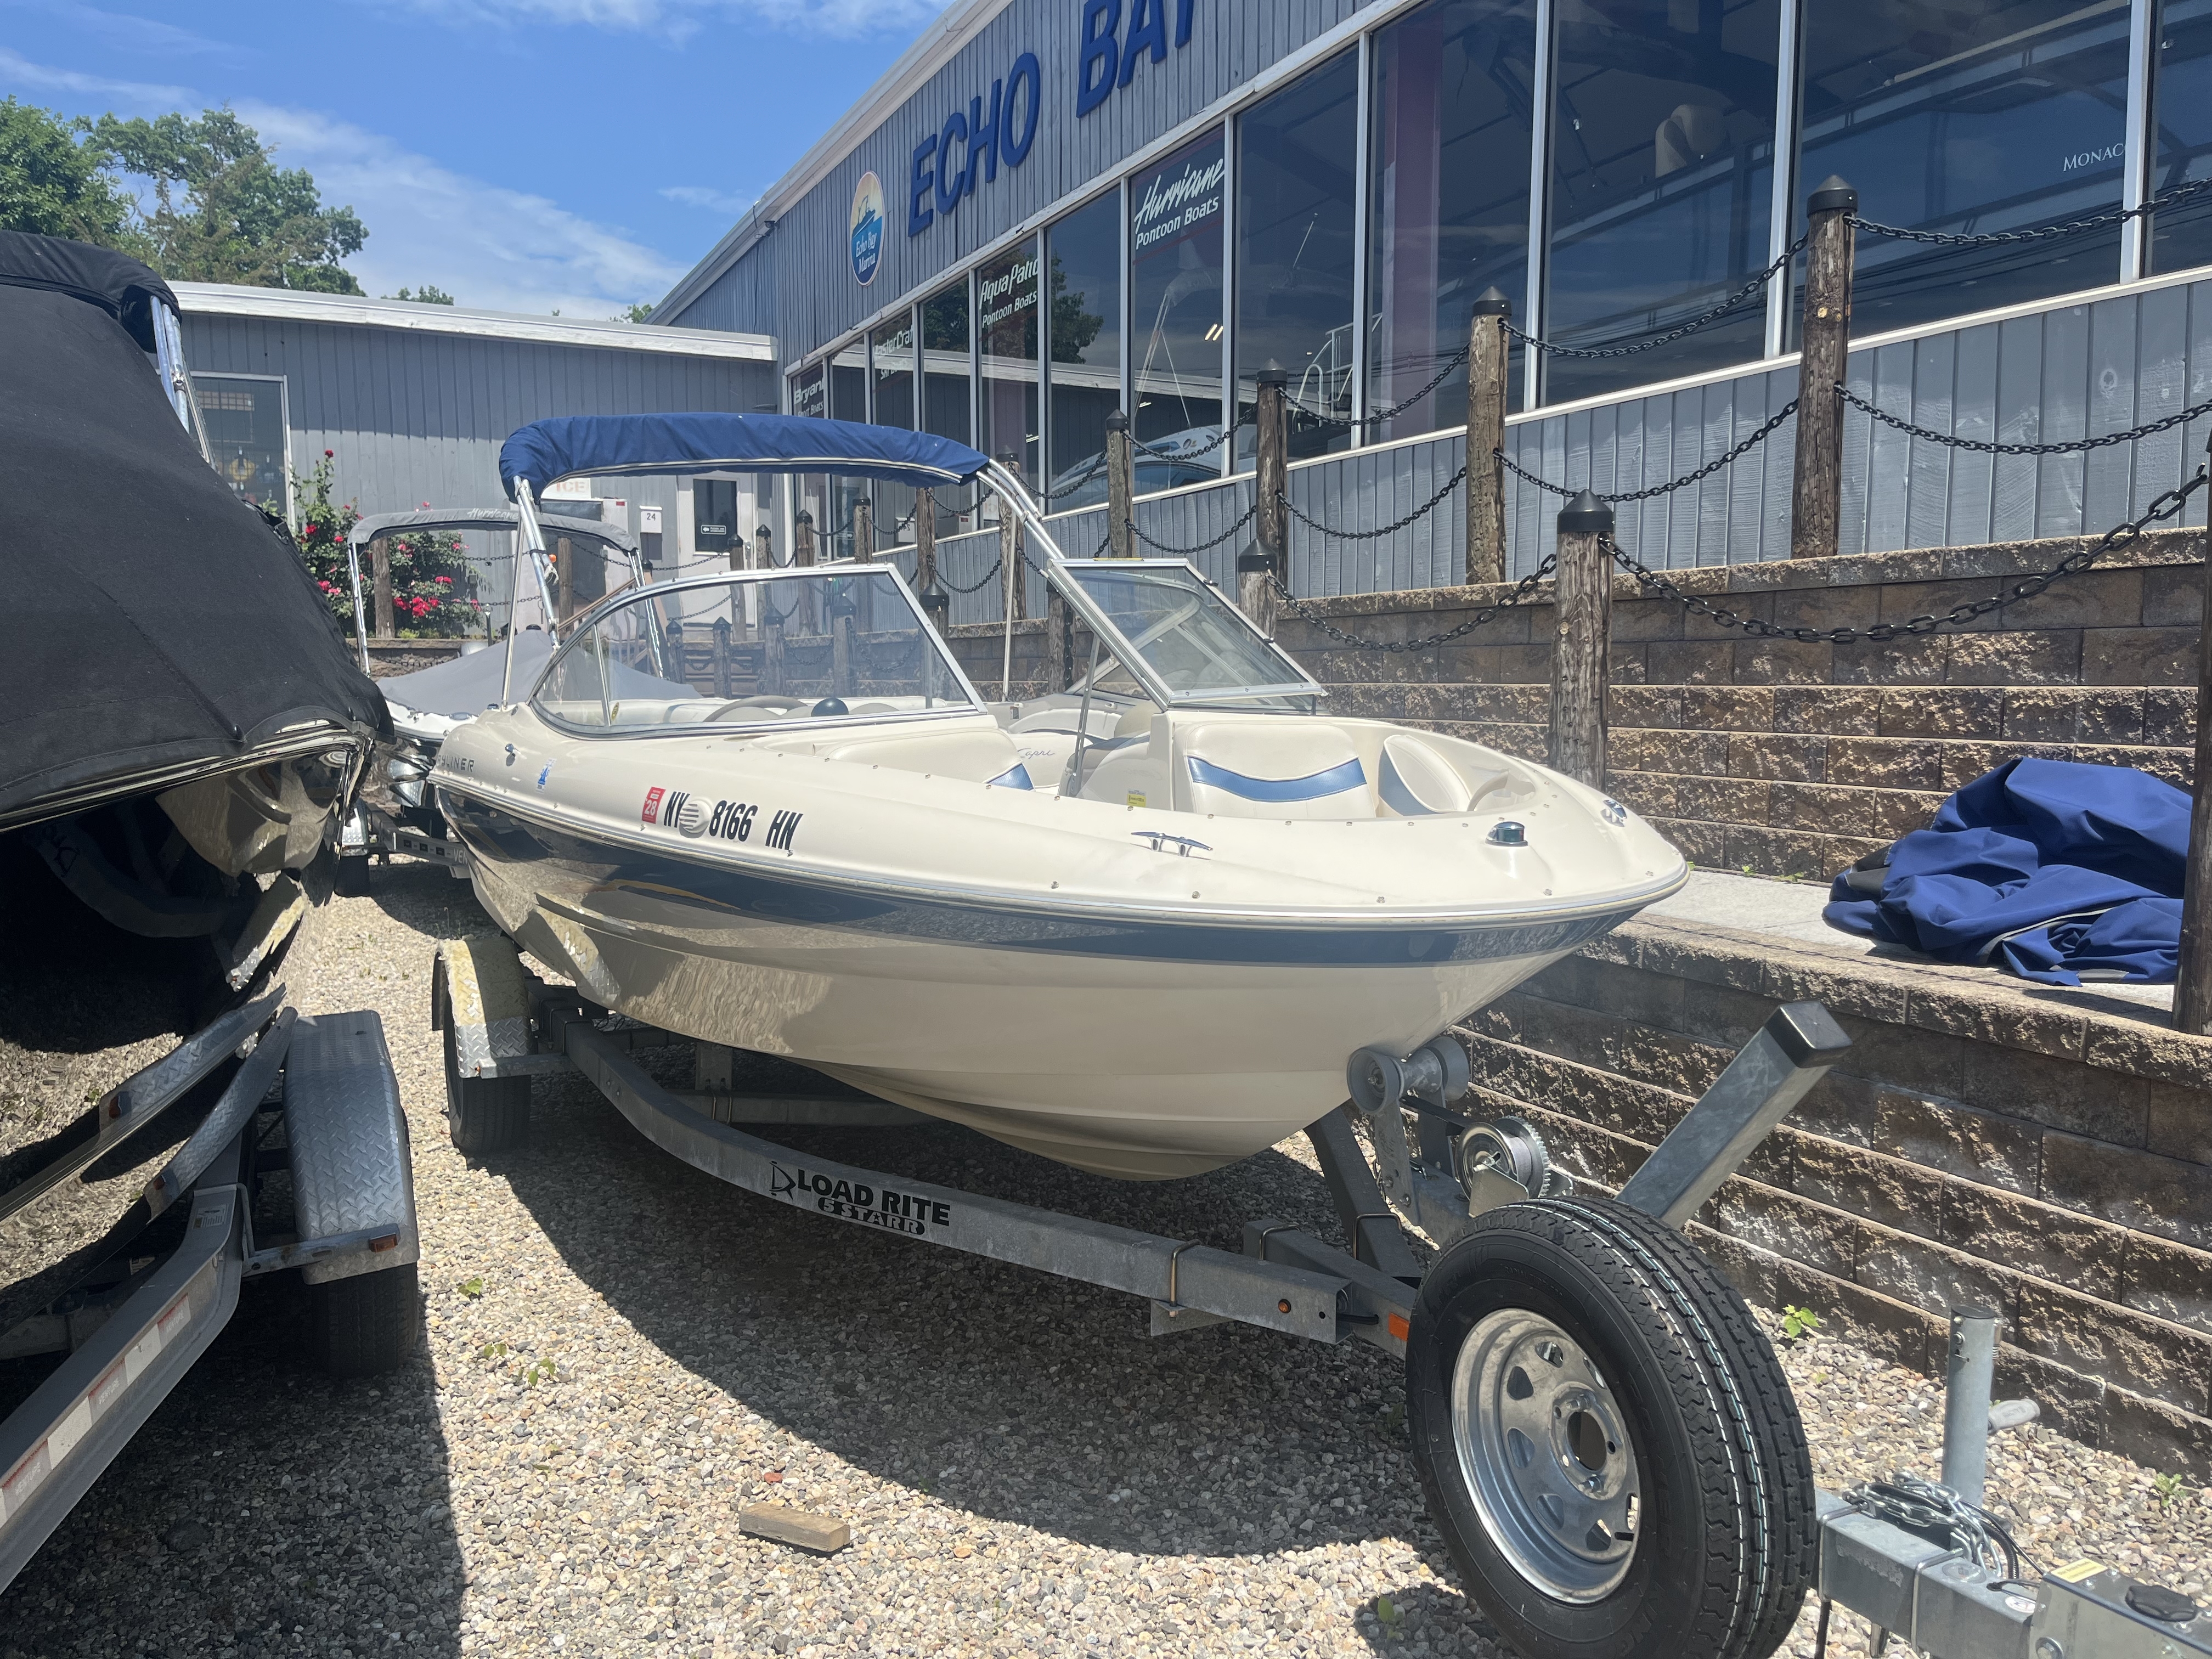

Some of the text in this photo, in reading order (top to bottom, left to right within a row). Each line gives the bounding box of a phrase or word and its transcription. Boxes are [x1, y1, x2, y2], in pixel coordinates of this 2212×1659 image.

[908, 52, 1040, 237] ECHO
[2063, 143, 2126, 172] MONAC
[1134, 158, 1224, 235] Hurricane
[1136, 196, 1219, 250] Pontoon Boats
[856, 232, 877, 258] Echo Bay
[858, 252, 876, 274] Marina
[982, 290, 1037, 329] Pontoon Boats
[871, 324, 913, 363] MasterCraf
[810, 401, 823, 415] Boats
[556, 481, 585, 493] ICE
[467, 508, 519, 520] Hurricane
[437, 754, 475, 772] AYLINER
[663, 791, 804, 850] NY 8166 HN
[798, 1169, 951, 1227] LOAD RITE
[823, 1199, 919, 1234] 5 STARR
